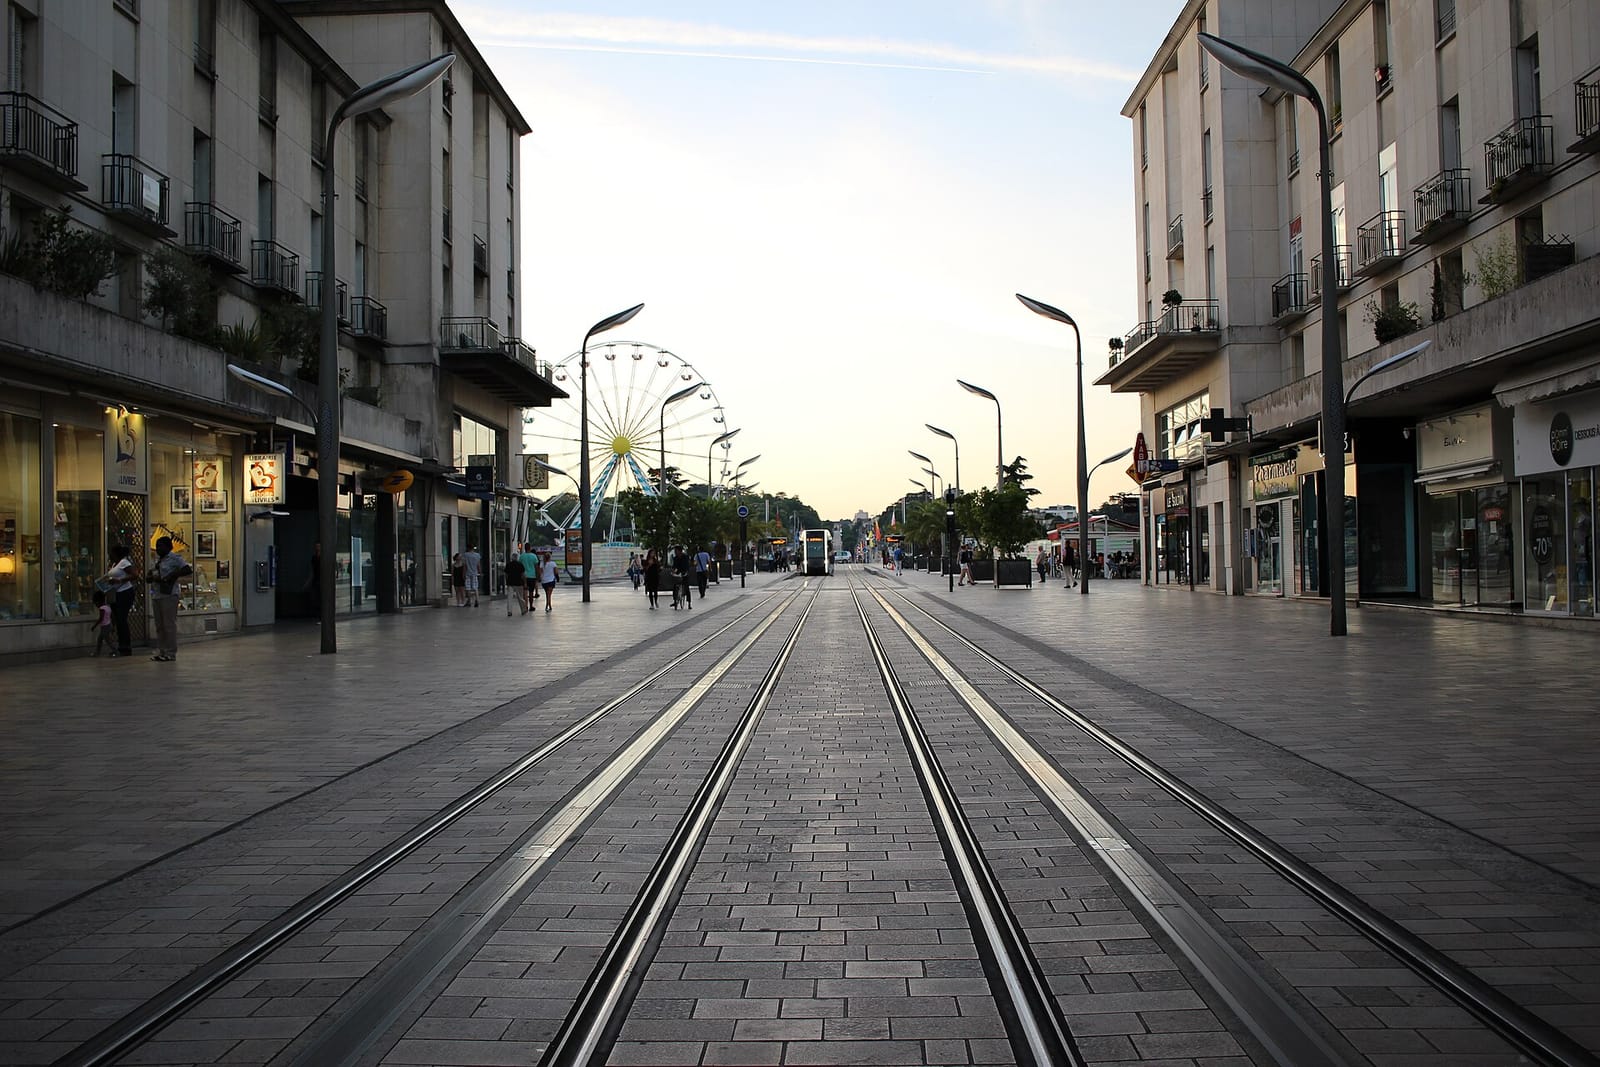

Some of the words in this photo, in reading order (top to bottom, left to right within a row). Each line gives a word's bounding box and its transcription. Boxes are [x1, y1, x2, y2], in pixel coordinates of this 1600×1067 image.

[1575, 427, 1596, 440] DESSOUS
[1254, 459, 1297, 482] Pharmacie
[1533, 536, 1552, 556] -70%
